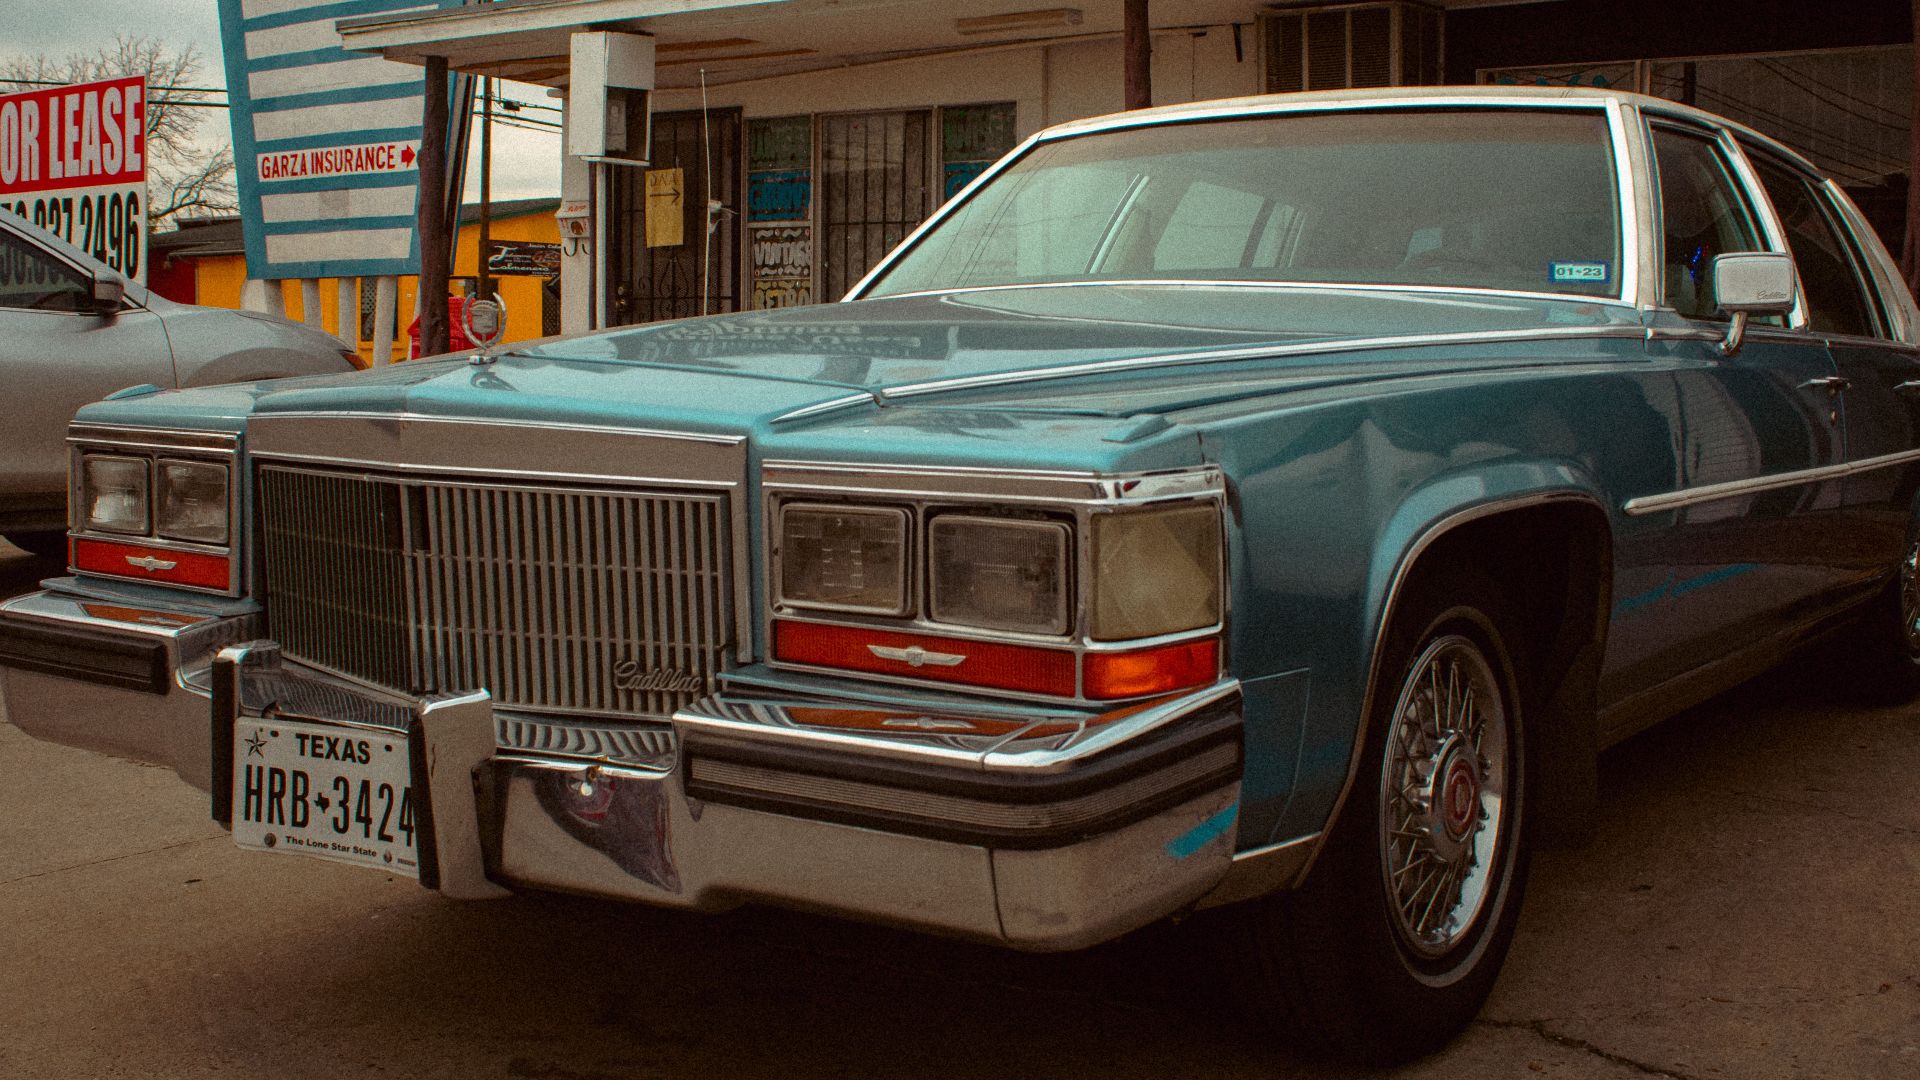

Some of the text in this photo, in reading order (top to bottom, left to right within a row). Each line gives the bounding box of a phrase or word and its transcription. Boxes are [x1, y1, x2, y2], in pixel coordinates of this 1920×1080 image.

[49, 85, 143, 180] LEASE
[261, 145, 396, 179] GARZA INSURANCE
[80, 191, 140, 280] 2496
[614, 660, 702, 691] Cadillac
[296, 733, 370, 764] TEXAS
[244, 764, 414, 848] HRB 3424
[286, 836, 377, 857] The Lone Star State
